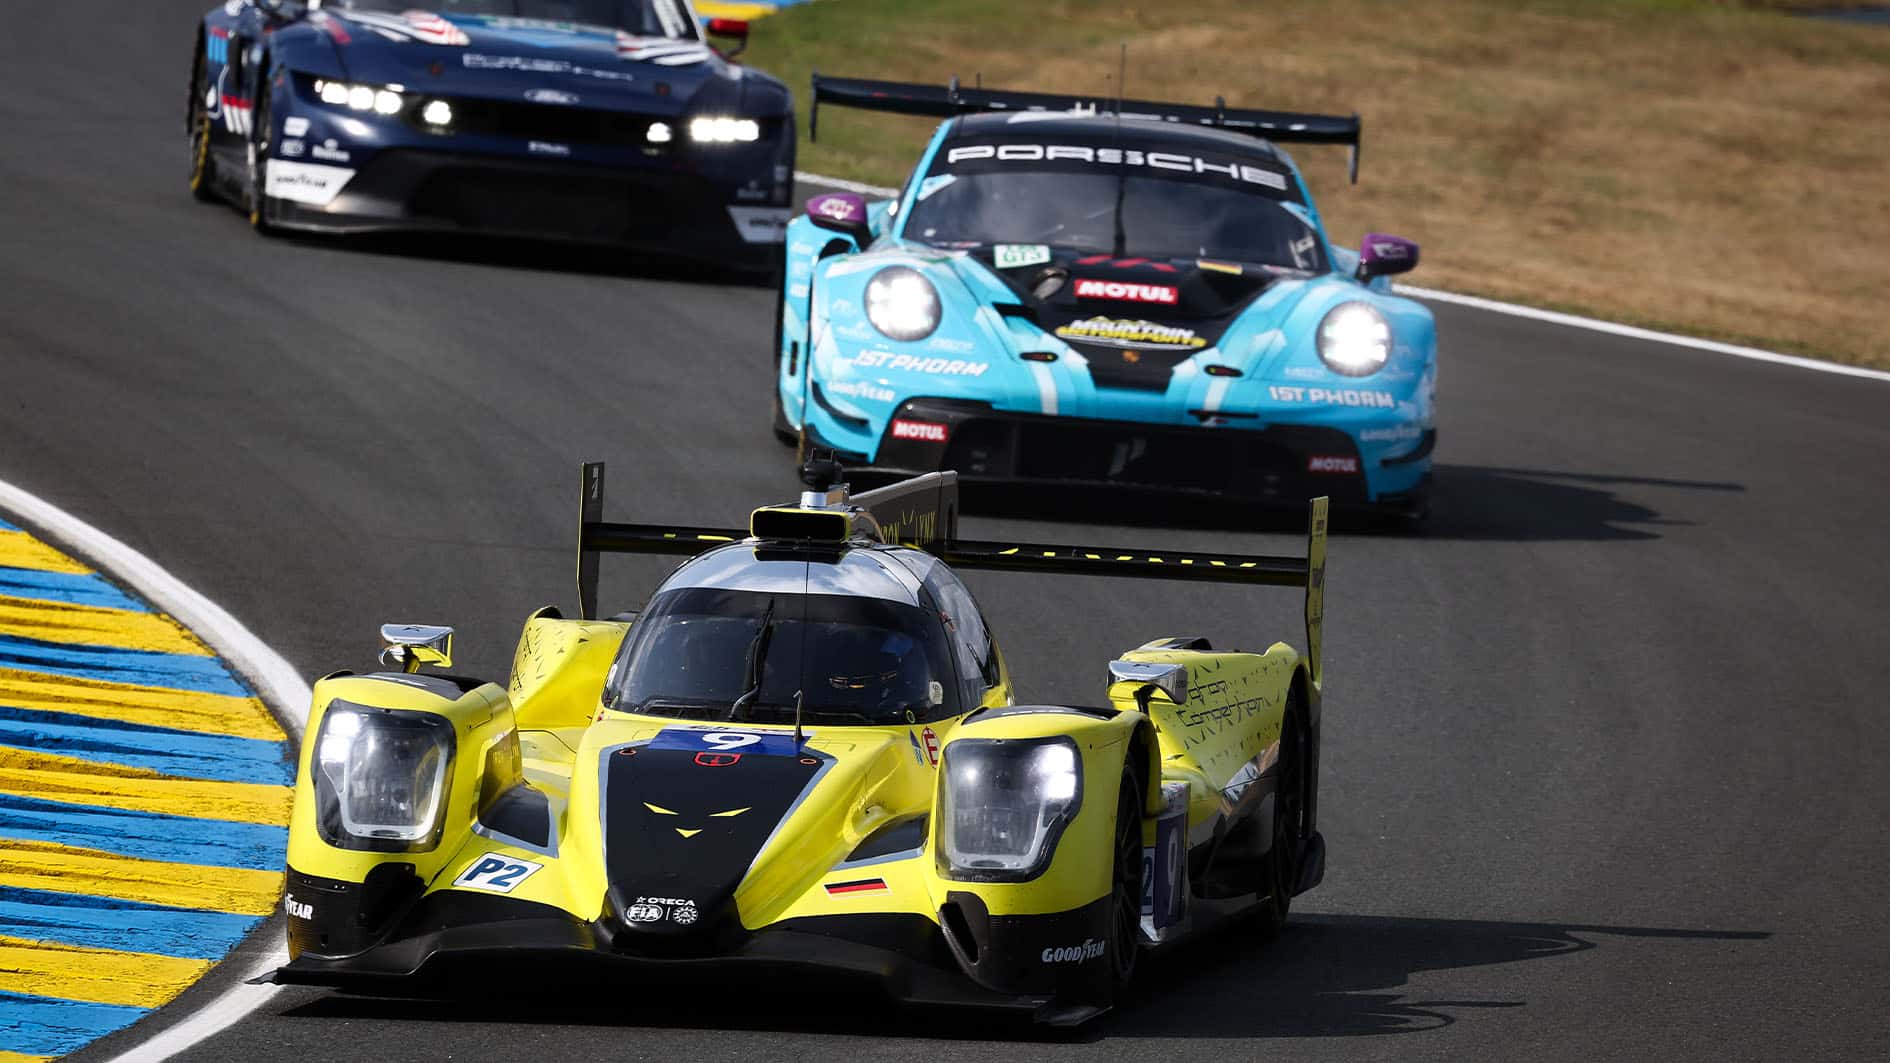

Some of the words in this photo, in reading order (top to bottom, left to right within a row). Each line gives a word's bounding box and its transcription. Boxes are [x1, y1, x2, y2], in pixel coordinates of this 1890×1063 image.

[948, 145, 1287, 190] PORSCHE
[1078, 280, 1175, 302] MOTUL
[854, 350, 895, 366] 1ST
[889, 355, 988, 376] PHORM
[1269, 386, 1306, 401] 1ST
[1309, 389, 1394, 409] PHORM
[894, 421, 946, 439] MOTUL
[1309, 457, 1357, 472] MOTUL
[702, 733, 762, 750] 9
[465, 857, 529, 885] P2
[647, 897, 695, 906] ORECA
[629, 906, 660, 919] FIA
